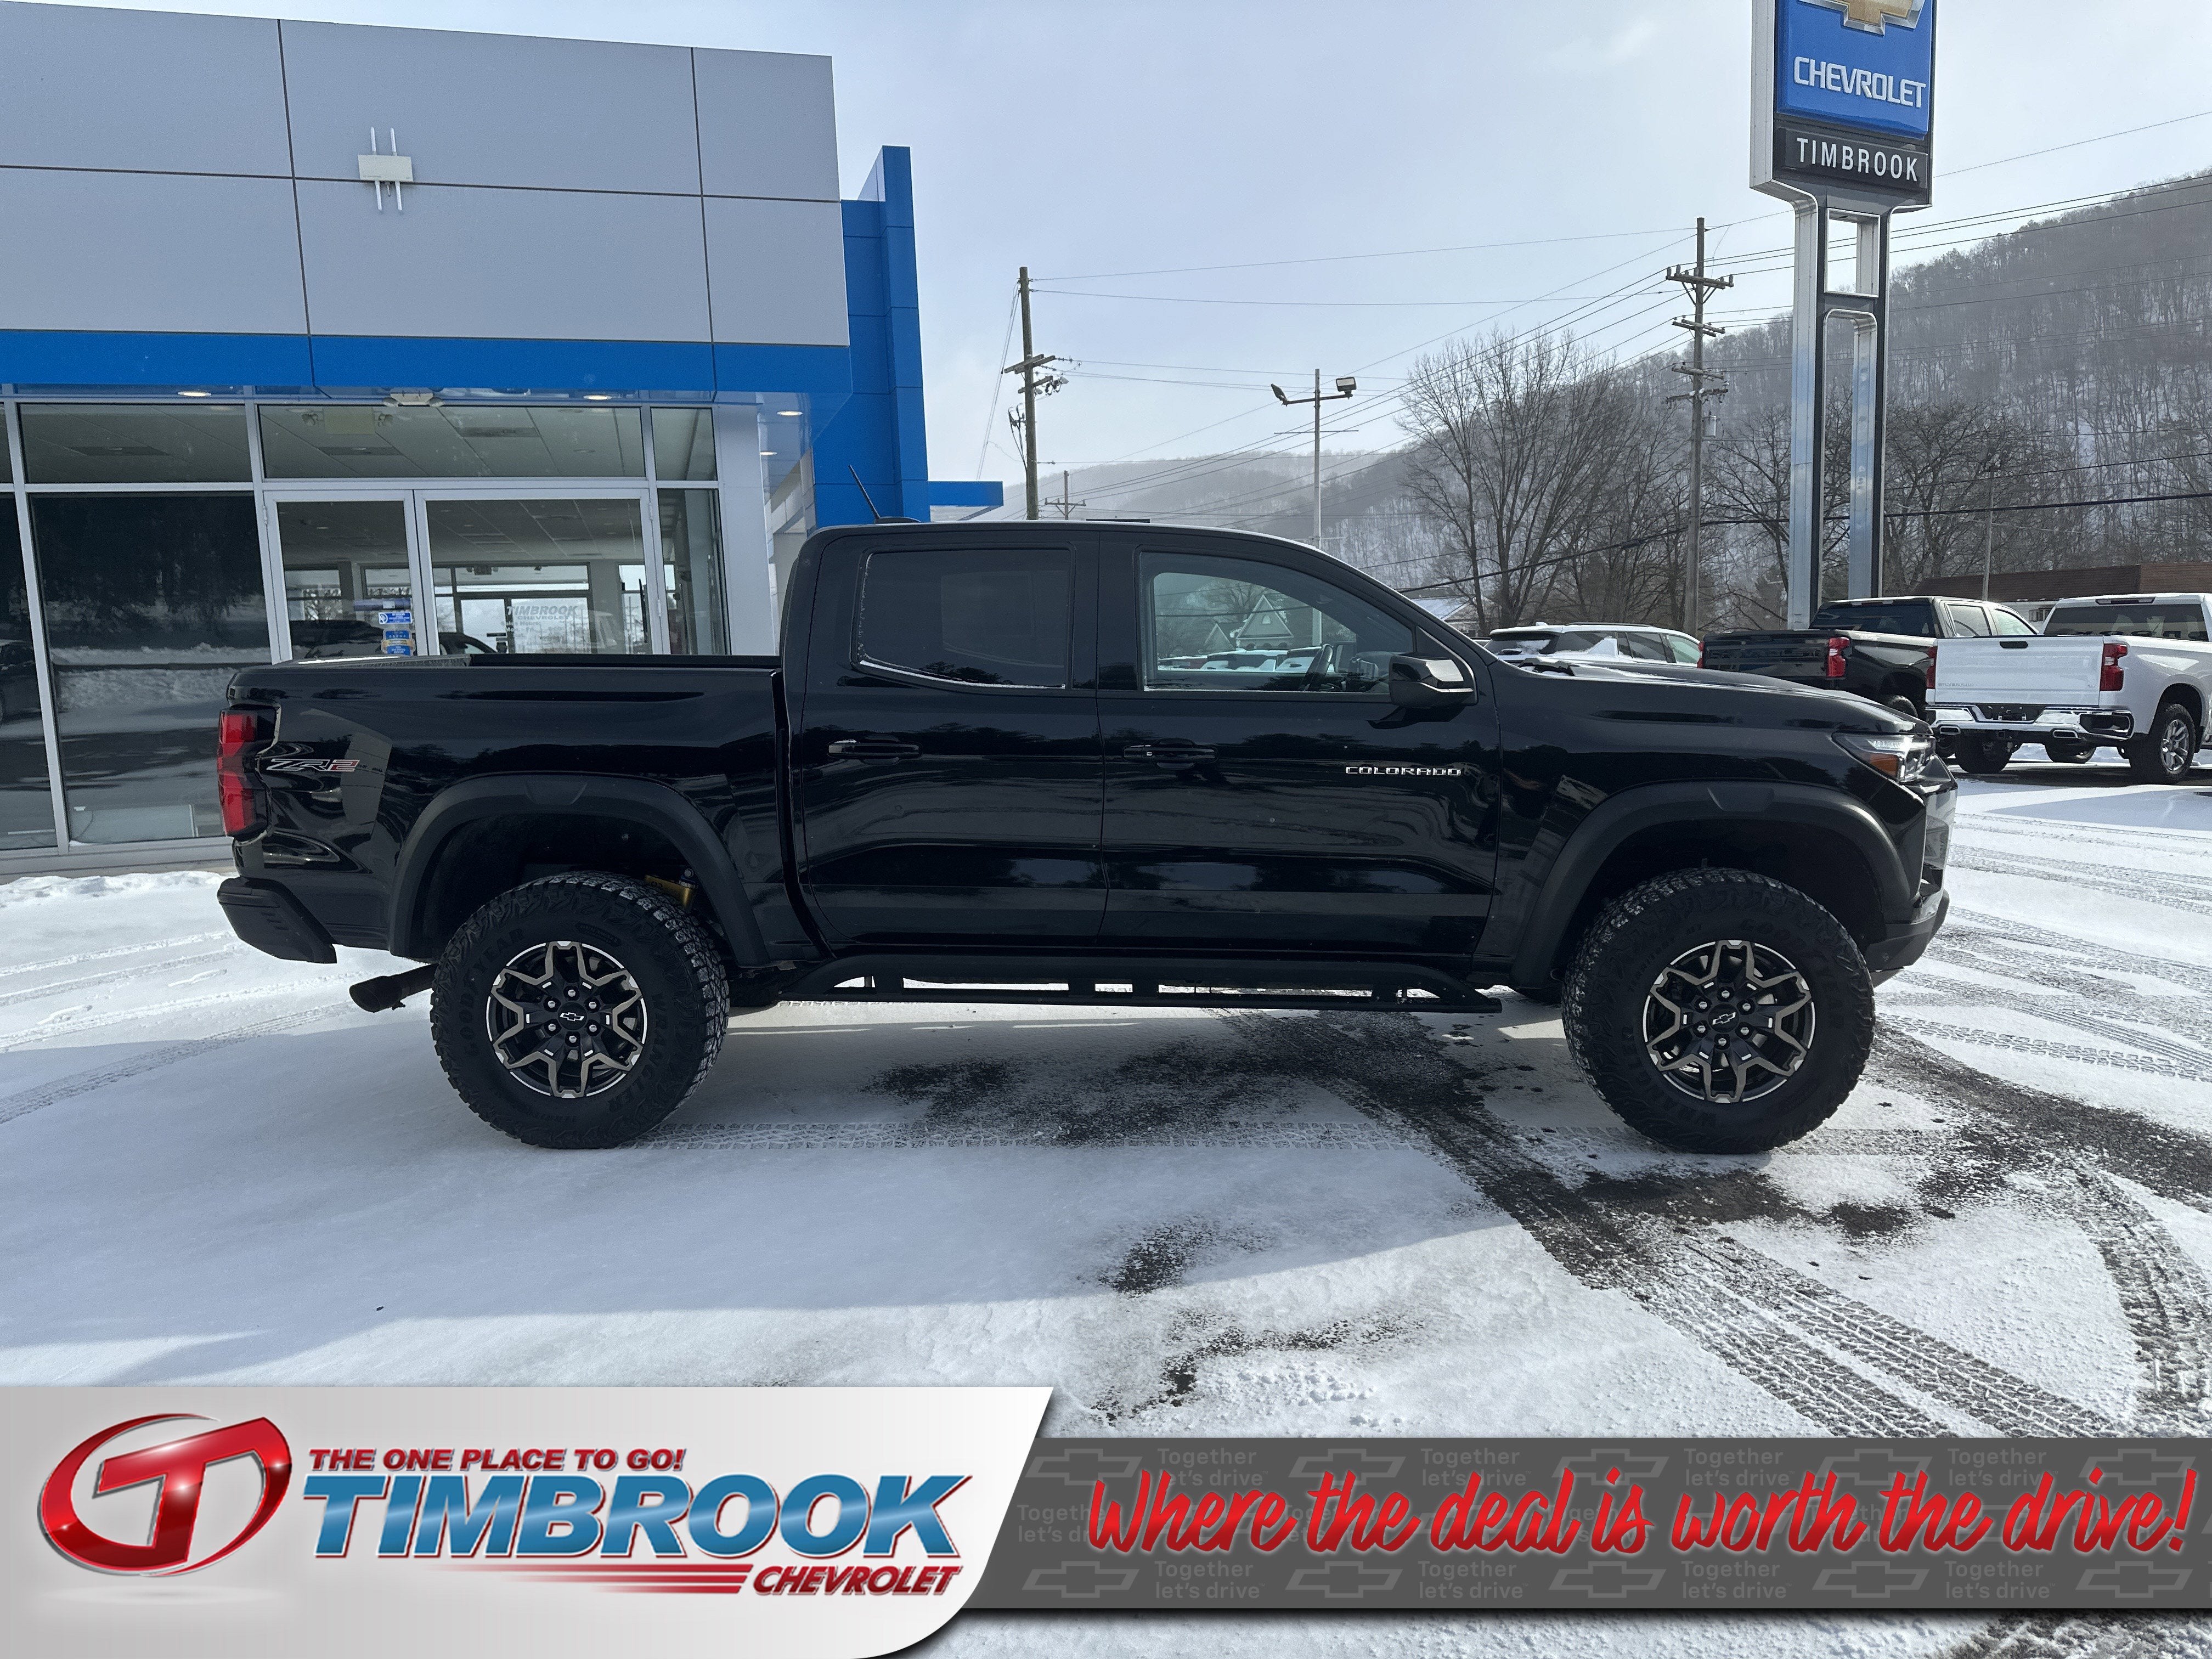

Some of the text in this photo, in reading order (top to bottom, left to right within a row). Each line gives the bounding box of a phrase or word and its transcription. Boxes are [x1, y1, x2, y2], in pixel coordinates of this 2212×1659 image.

[1793, 56, 1926, 108] CHEVROLET
[1797, 137, 1919, 182] TIMBROOK
[507, 606, 578, 616] TIMBROOK
[266, 759, 360, 772] ZR2
[1346, 766, 1462, 776] COLORADO
